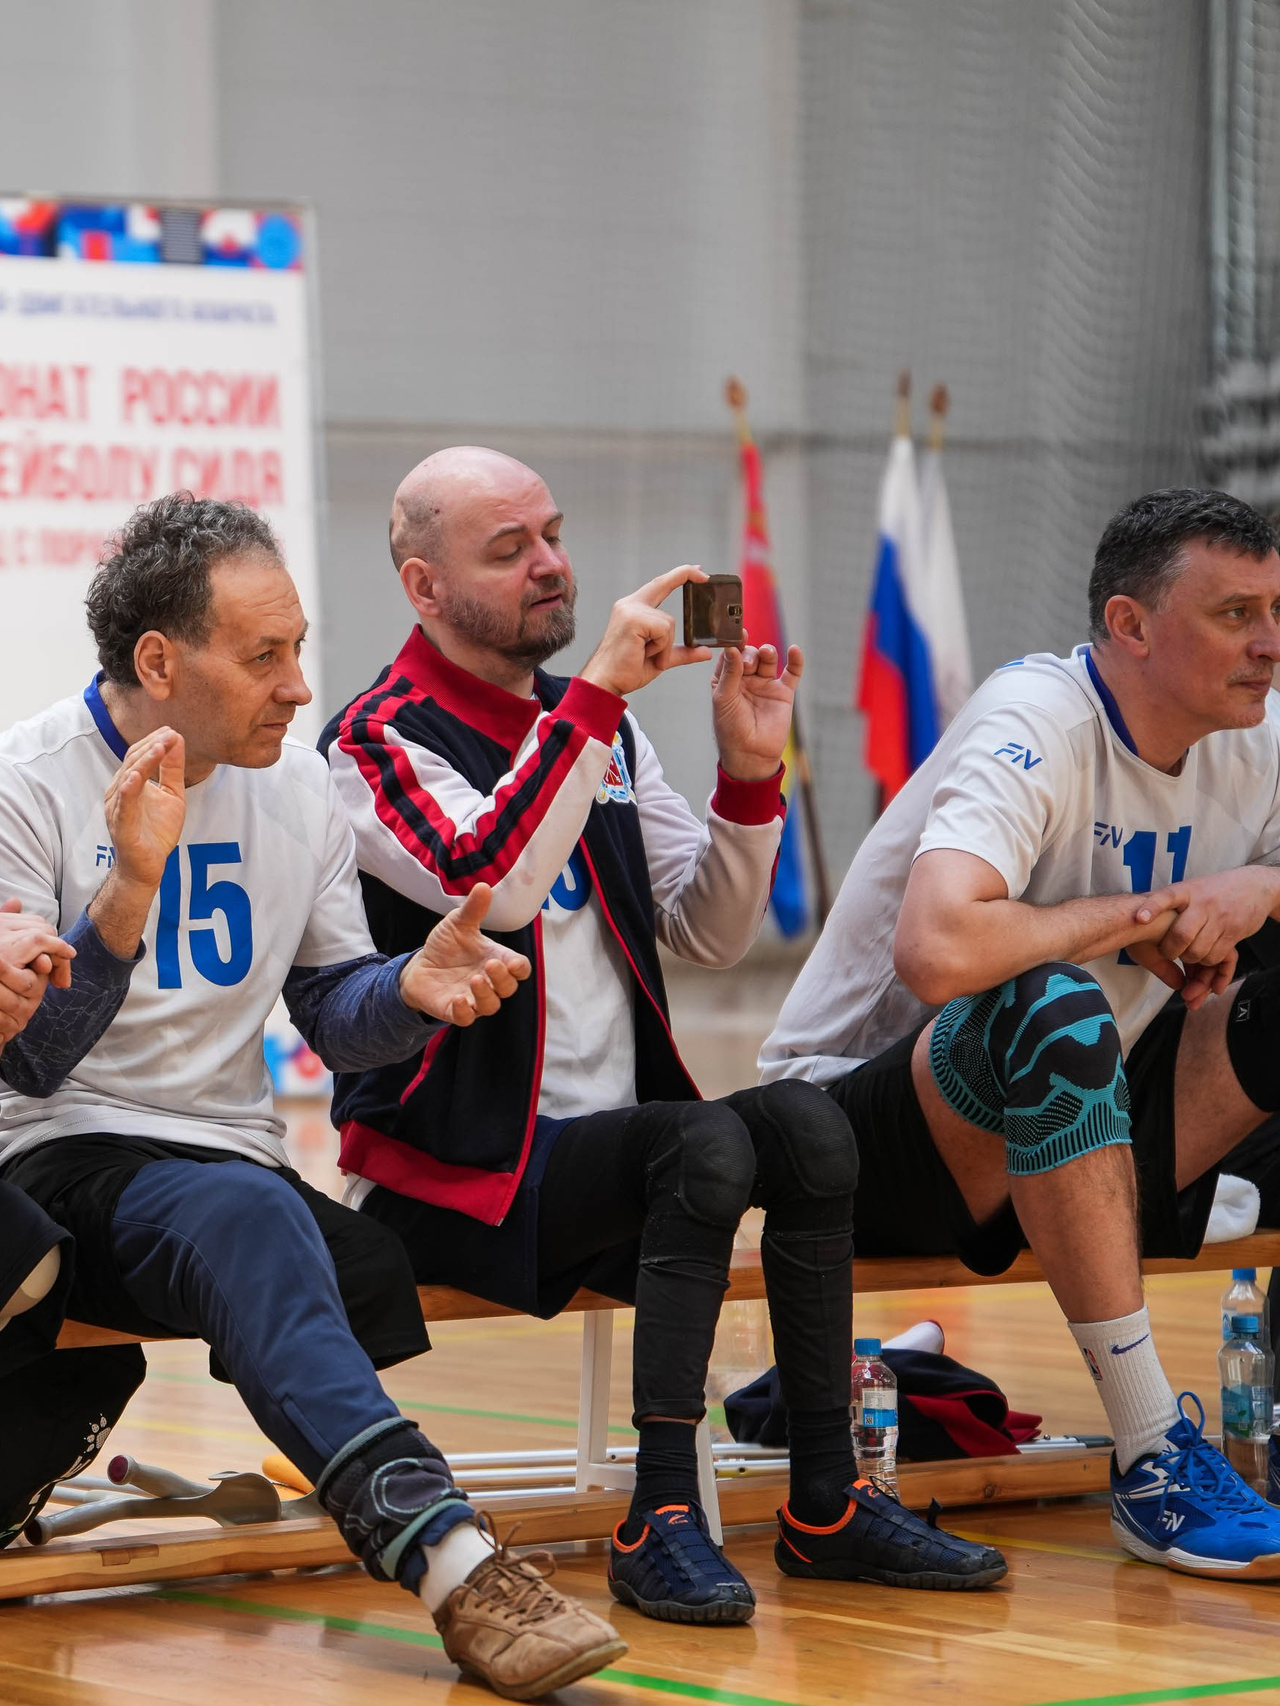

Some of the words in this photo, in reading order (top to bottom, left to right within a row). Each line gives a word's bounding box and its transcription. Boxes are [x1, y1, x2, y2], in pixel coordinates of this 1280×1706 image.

[122, 367, 282, 427] РОССИИ
[173, 447, 283, 508] СИДЯ
[156, 841, 253, 989] 15
